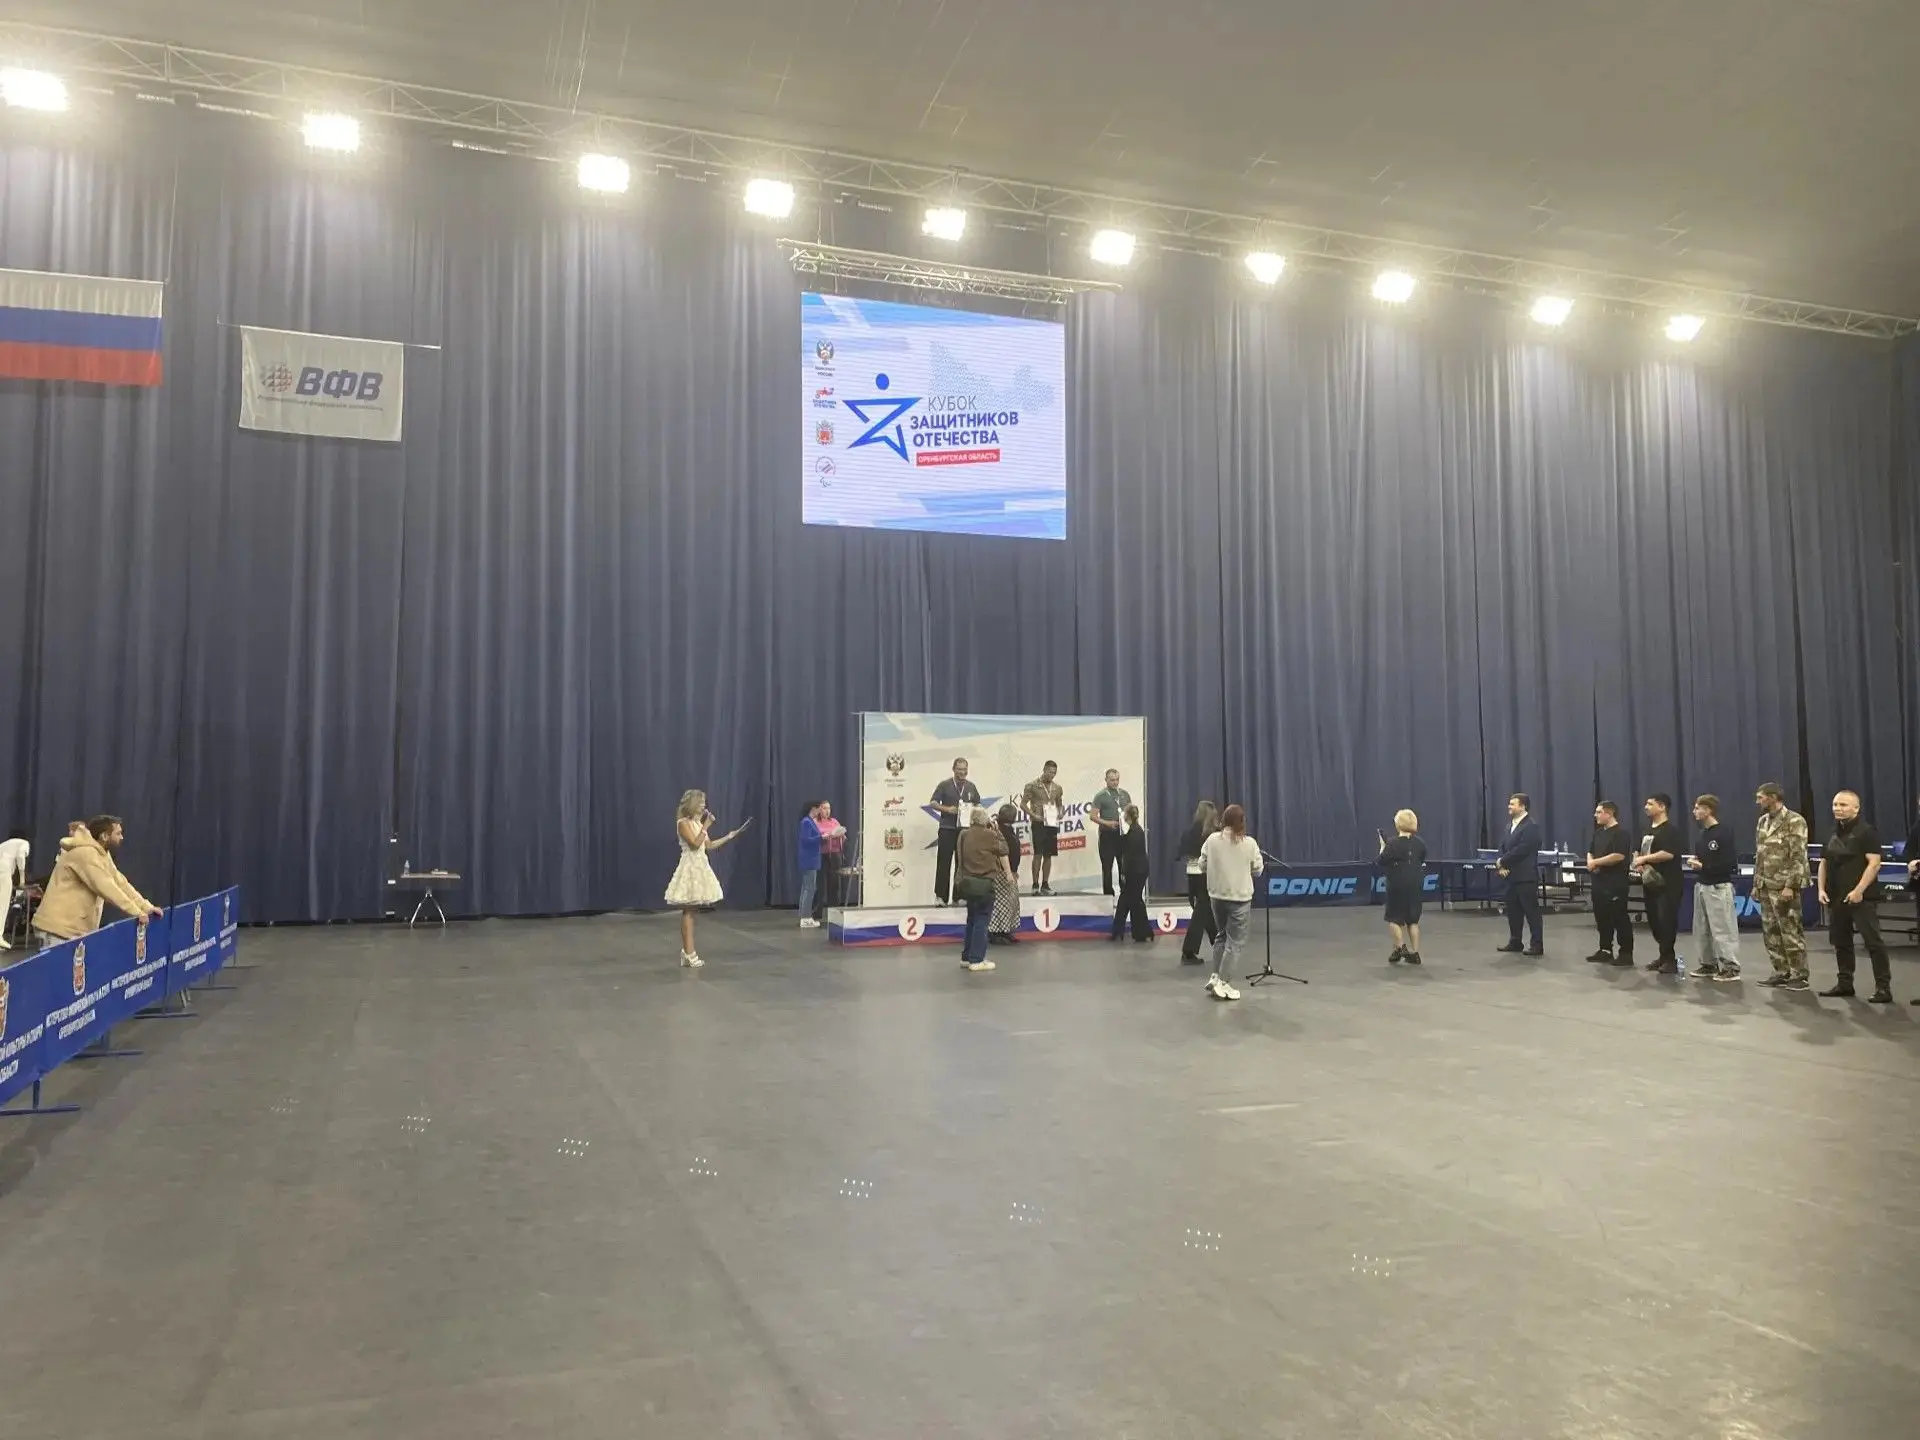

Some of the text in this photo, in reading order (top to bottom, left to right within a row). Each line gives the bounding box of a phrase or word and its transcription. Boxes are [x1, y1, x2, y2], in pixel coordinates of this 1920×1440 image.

[295, 366, 384, 401] ВФВ
[928, 395, 977, 412] КУБОК
[910, 411, 1019, 430] ЗАЩИТНИКОВ
[912, 430, 1000, 448] ОТЕЧЕСТВА
[1268, 876, 1358, 895] DONIC
[906, 916, 918, 936] 2
[1042, 908, 1051, 928] 1
[1162, 912, 1172, 928] 3
